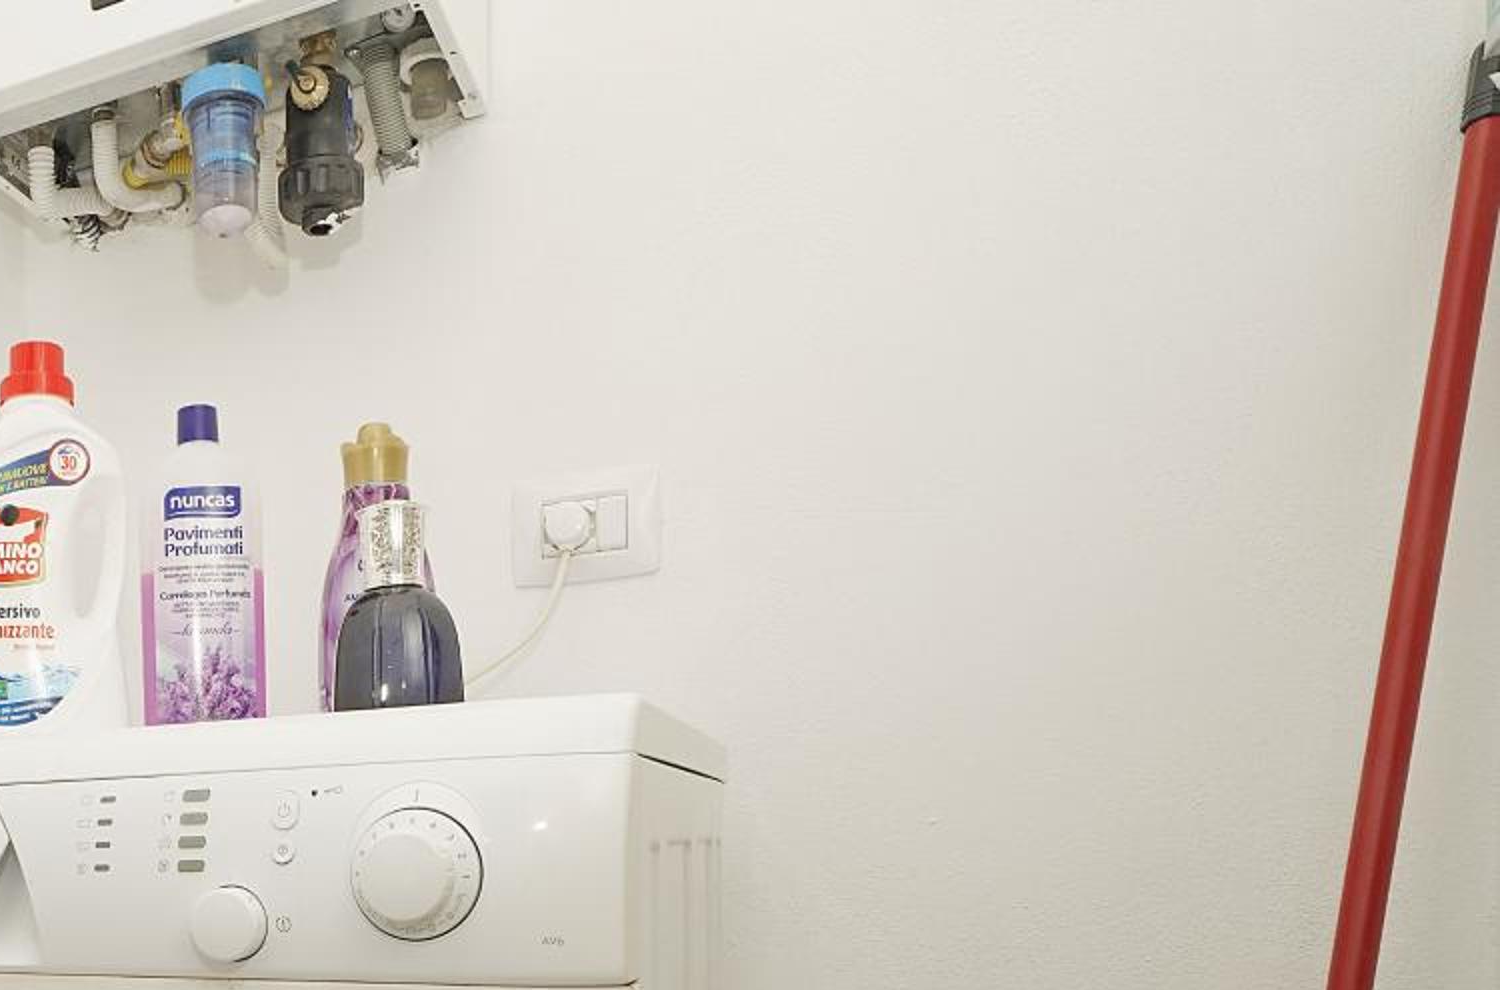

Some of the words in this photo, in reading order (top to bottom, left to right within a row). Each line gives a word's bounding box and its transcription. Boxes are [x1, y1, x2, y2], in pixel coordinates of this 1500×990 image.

[60, 456, 76, 470] 30
[170, 495, 235, 509] nuncas
[164, 525, 243, 541] Pavimenti
[165, 541, 243, 557] Profumati
